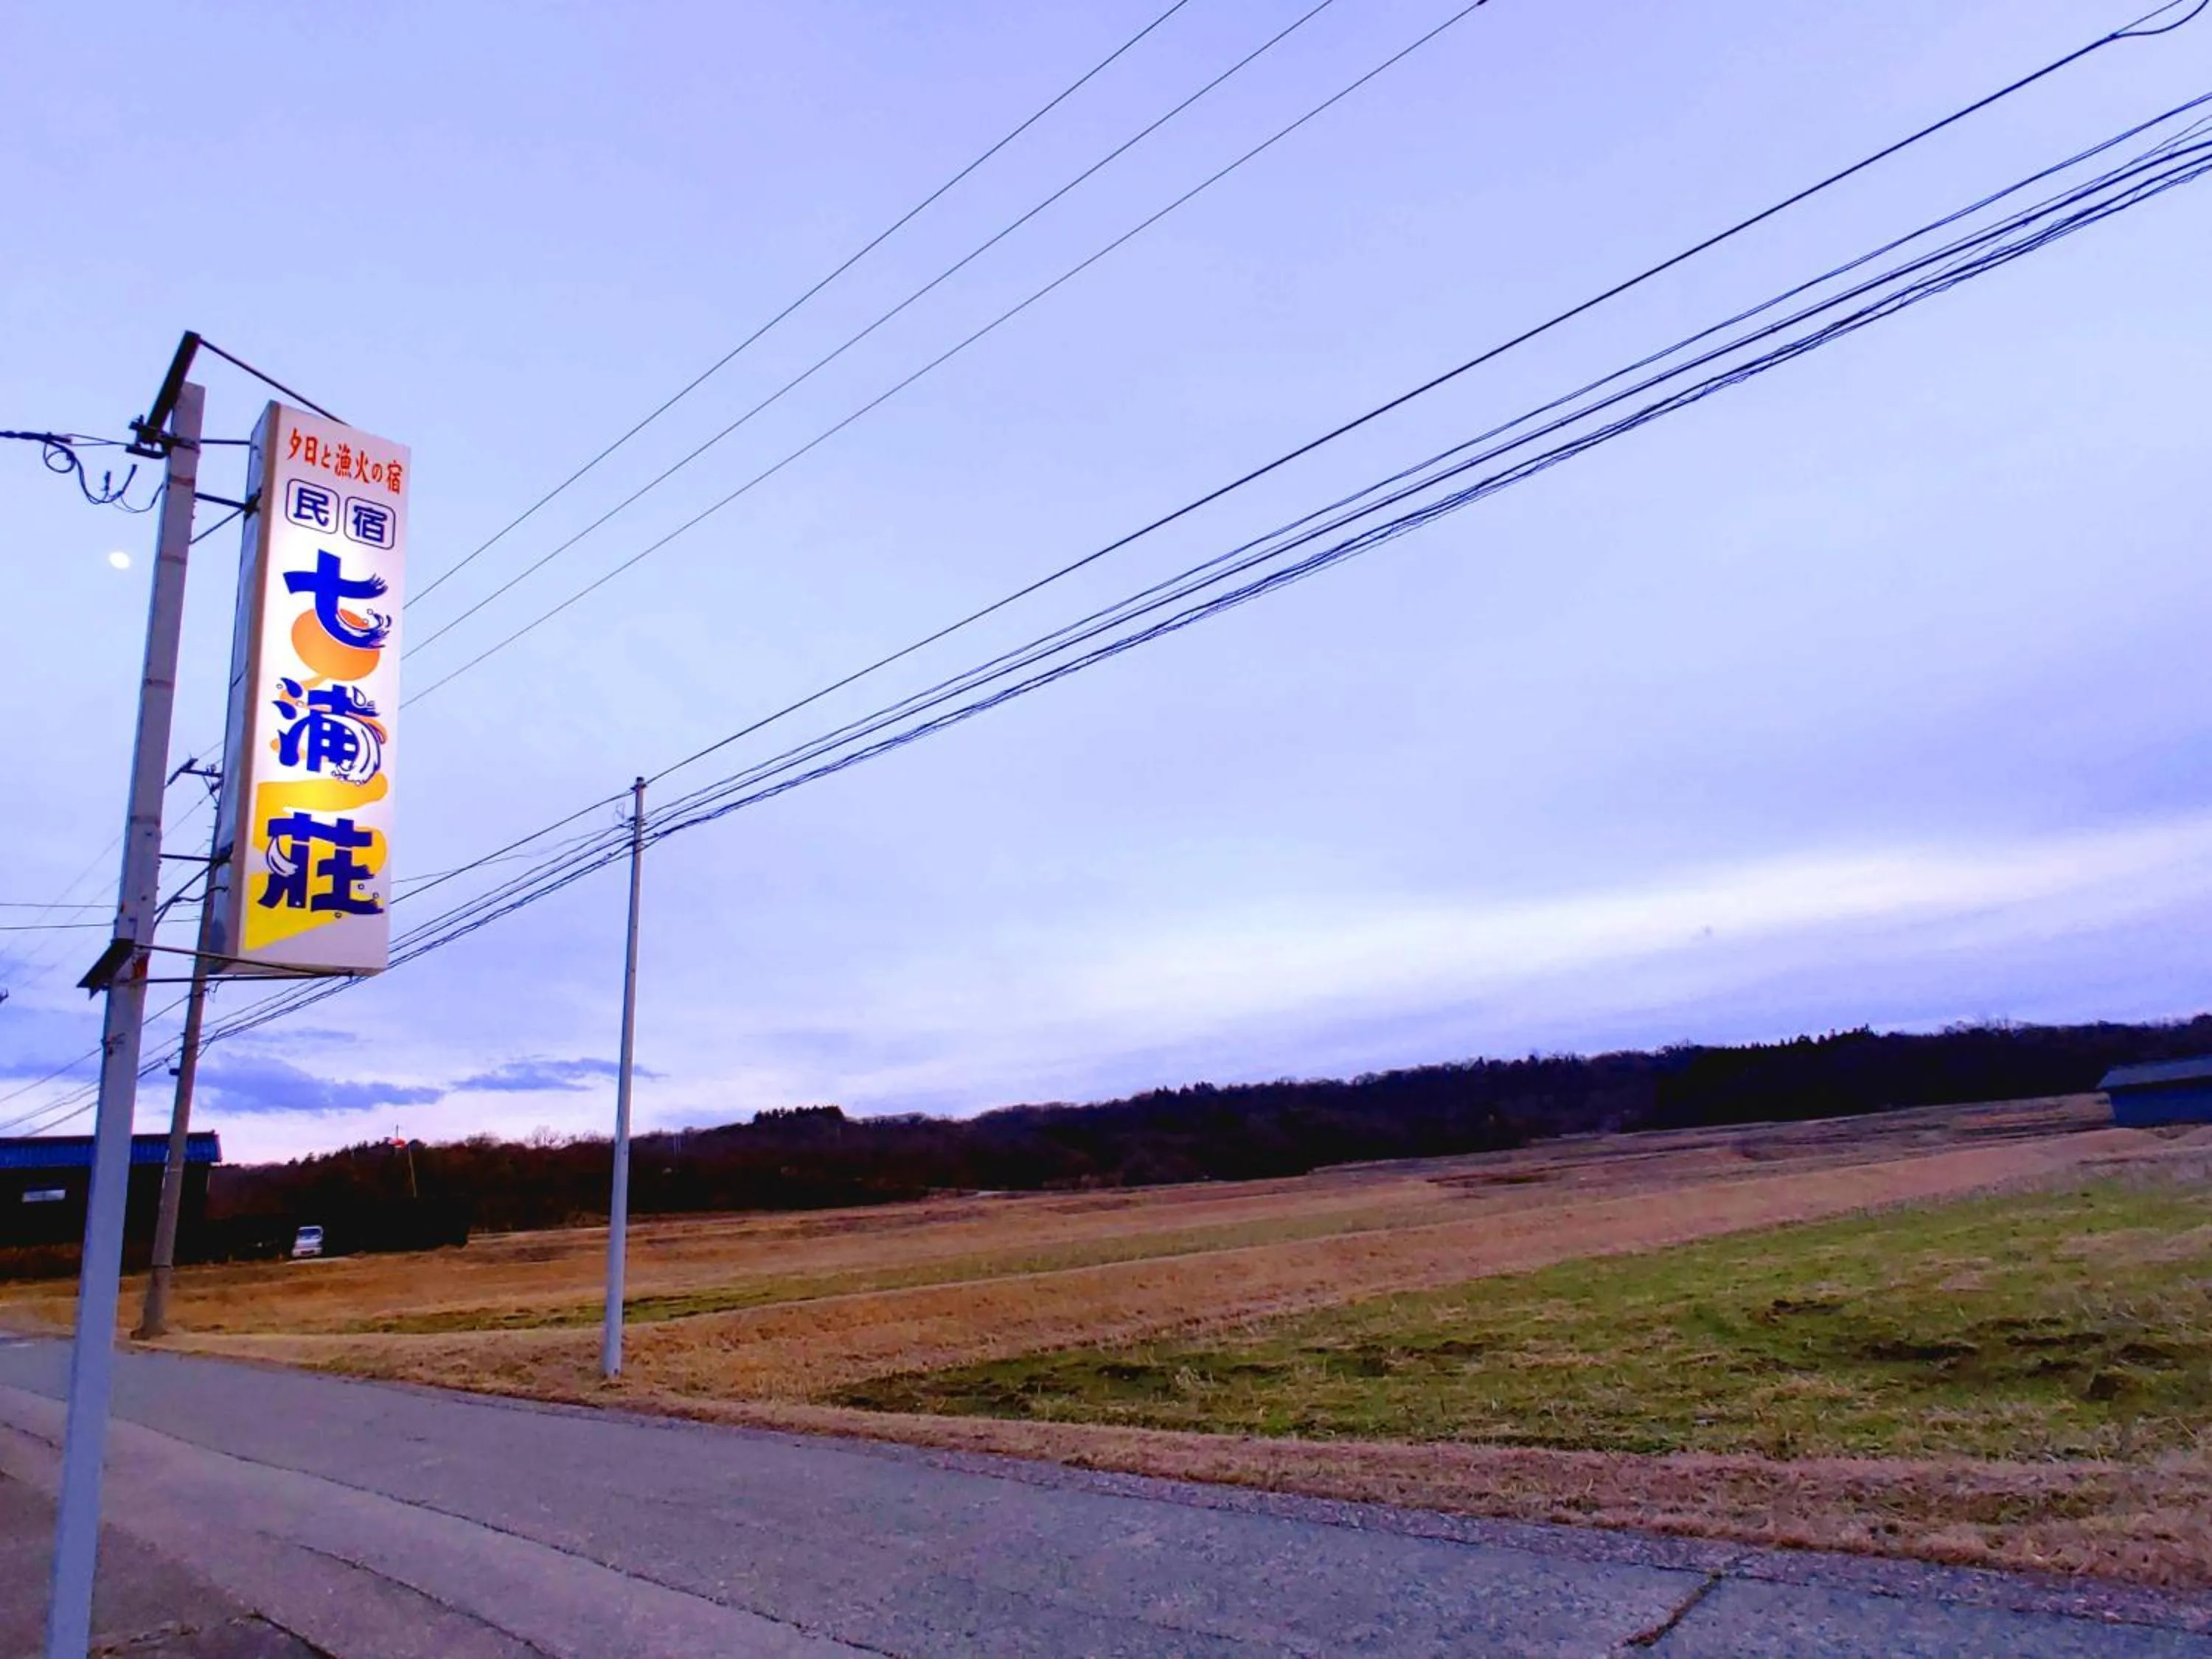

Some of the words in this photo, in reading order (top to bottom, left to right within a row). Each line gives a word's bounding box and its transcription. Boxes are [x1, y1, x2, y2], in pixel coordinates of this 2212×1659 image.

[287, 428, 403, 495] 夕日と漁火の宿
[293, 487, 388, 543] 民宿
